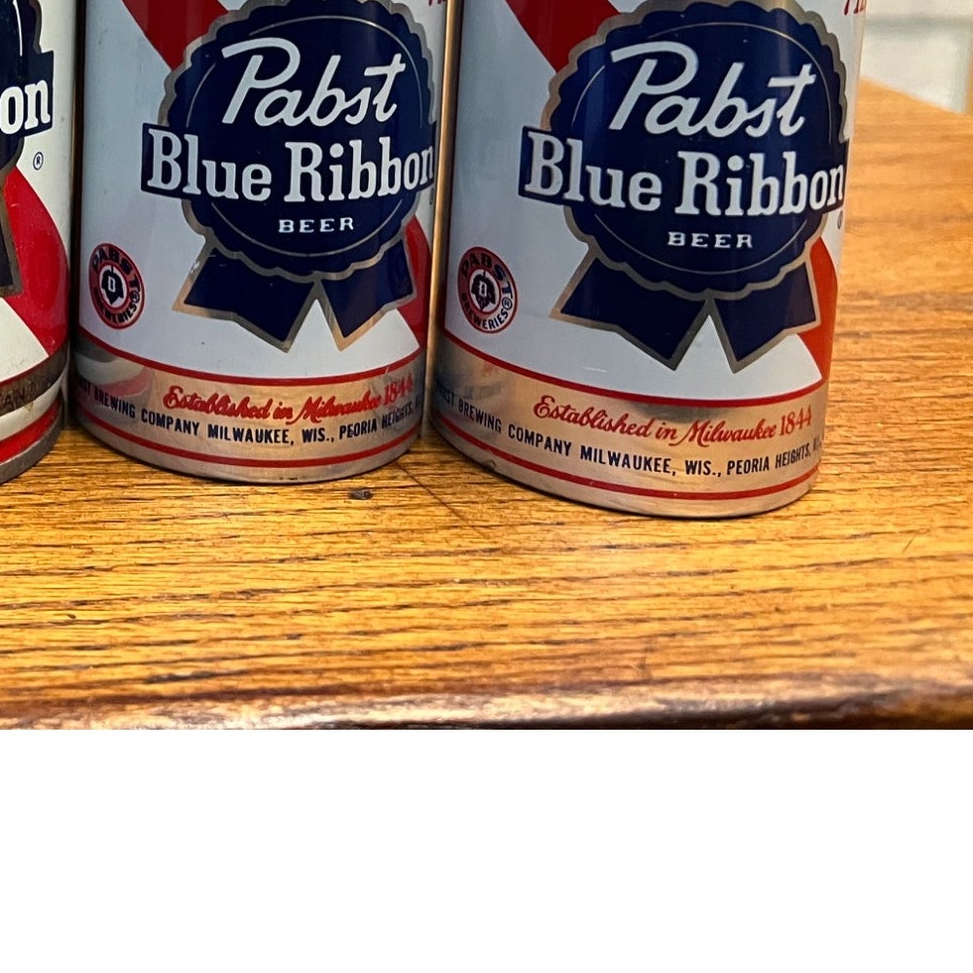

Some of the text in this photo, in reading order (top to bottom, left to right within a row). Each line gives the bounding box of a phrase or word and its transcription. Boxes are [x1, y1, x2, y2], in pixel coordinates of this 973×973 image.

[221, 36, 407, 127] Pabst
[610, 40, 817, 138] Pabst
[147, 128, 434, 203] Blue Ribbon
[523, 130, 844, 217] Blue Ribbon
[278, 217, 354, 233] BEER
[667, 232, 753, 249] BEER
[460, 252, 513, 299] PABST
[94, 389, 136, 419] BREWING
[141, 408, 200, 436] COMPANY
[207, 423, 294, 446] MILWAUKEE,
[302, 428, 335, 444] WIS.,
[339, 418, 377, 440] PEORIA
[162, 384, 273, 420] Established
[272, 401, 295, 420] in
[285, 390, 382, 425] Milwaukee
[383, 373, 413, 407] 1844
[533, 394, 655, 437] Established
[655, 421, 678, 441] in
[668, 418, 777, 447] Milwaukee
[779, 403, 812, 437] 1844
[457, 398, 502, 434] BREWING
[508, 423, 573, 457] COMPANY
[580, 444, 677, 477] MILWAUKEE,
[684, 459, 722, 478] WIS.,
[727, 456, 770, 475] PEORIA
